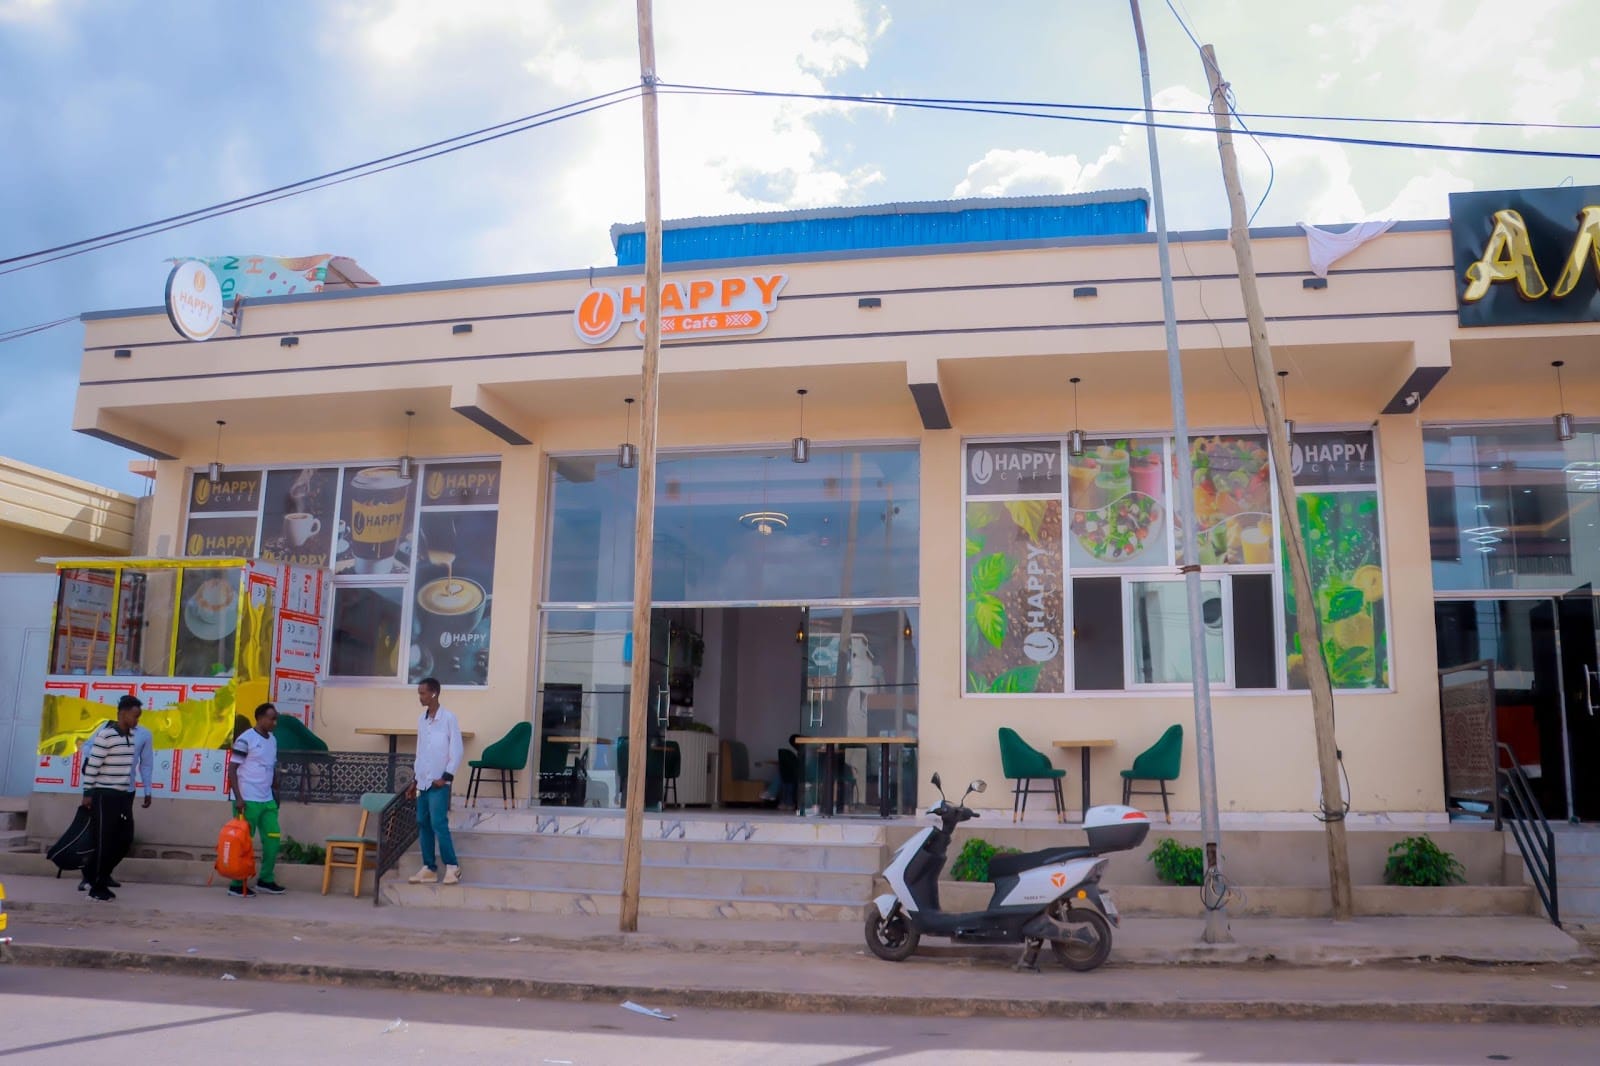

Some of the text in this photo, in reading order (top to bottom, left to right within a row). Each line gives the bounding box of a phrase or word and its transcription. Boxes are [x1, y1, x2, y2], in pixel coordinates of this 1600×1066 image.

[622, 275, 783, 315] HAPPY
[179, 291, 214, 316] HAPPY
[682, 316, 718, 330] Café
[1304, 443, 1369, 462] HAPPY
[995, 453, 1056, 471] HAPPY
[211, 480, 257, 495] HAPPY
[446, 474, 497, 488] HAPPY
[366, 513, 403, 527] HAPPY
[206, 536, 254, 550] HAPPY
[1027, 543, 1049, 628] HAPPY
[453, 633, 487, 642] HAPPY
